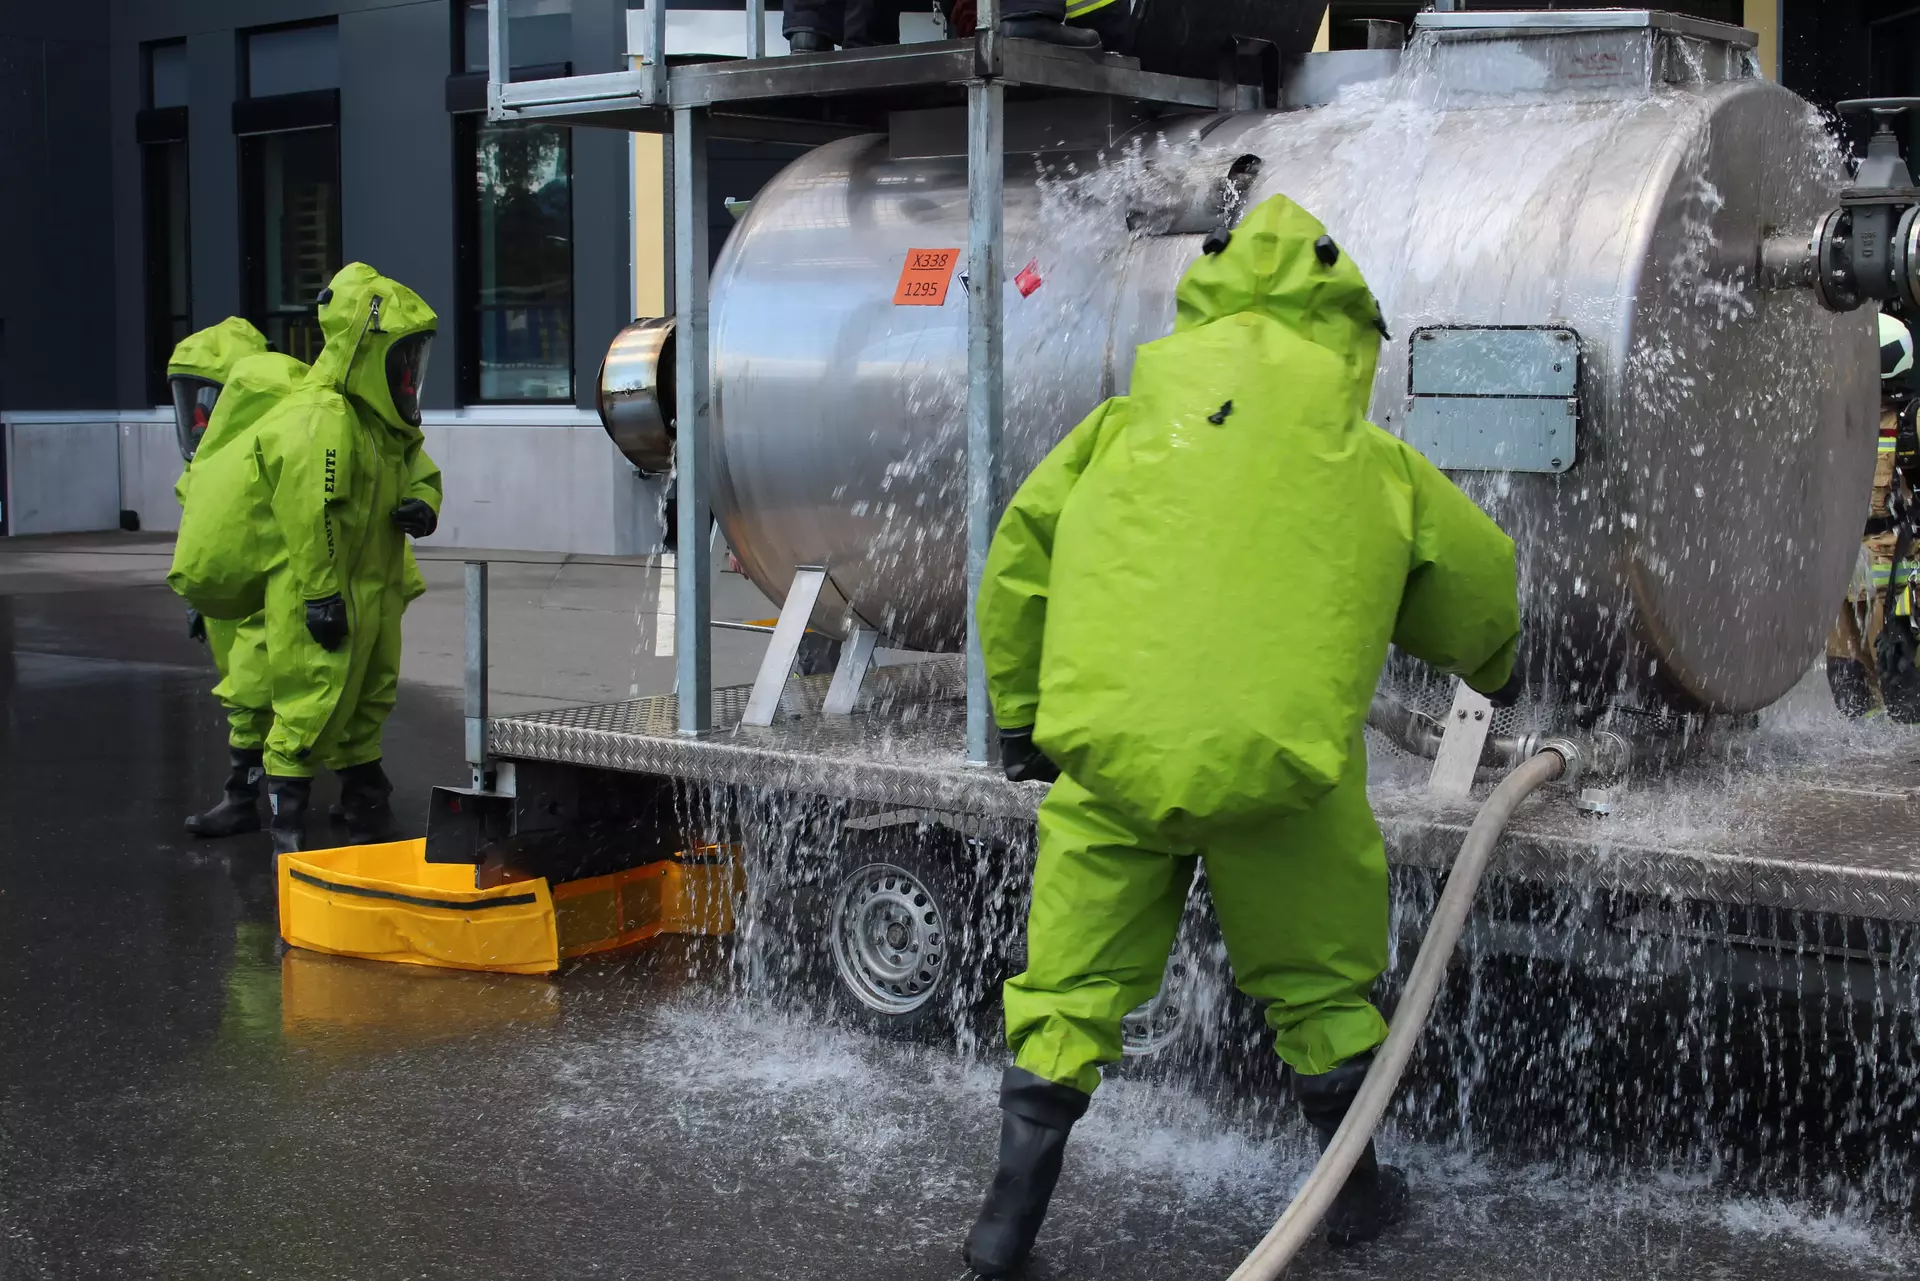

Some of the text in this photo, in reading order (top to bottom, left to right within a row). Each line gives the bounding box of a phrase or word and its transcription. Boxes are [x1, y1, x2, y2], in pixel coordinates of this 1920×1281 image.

[913, 254, 948, 268] X338
[904, 282, 938, 296] 1295
[325, 449, 336, 493] ELITE
